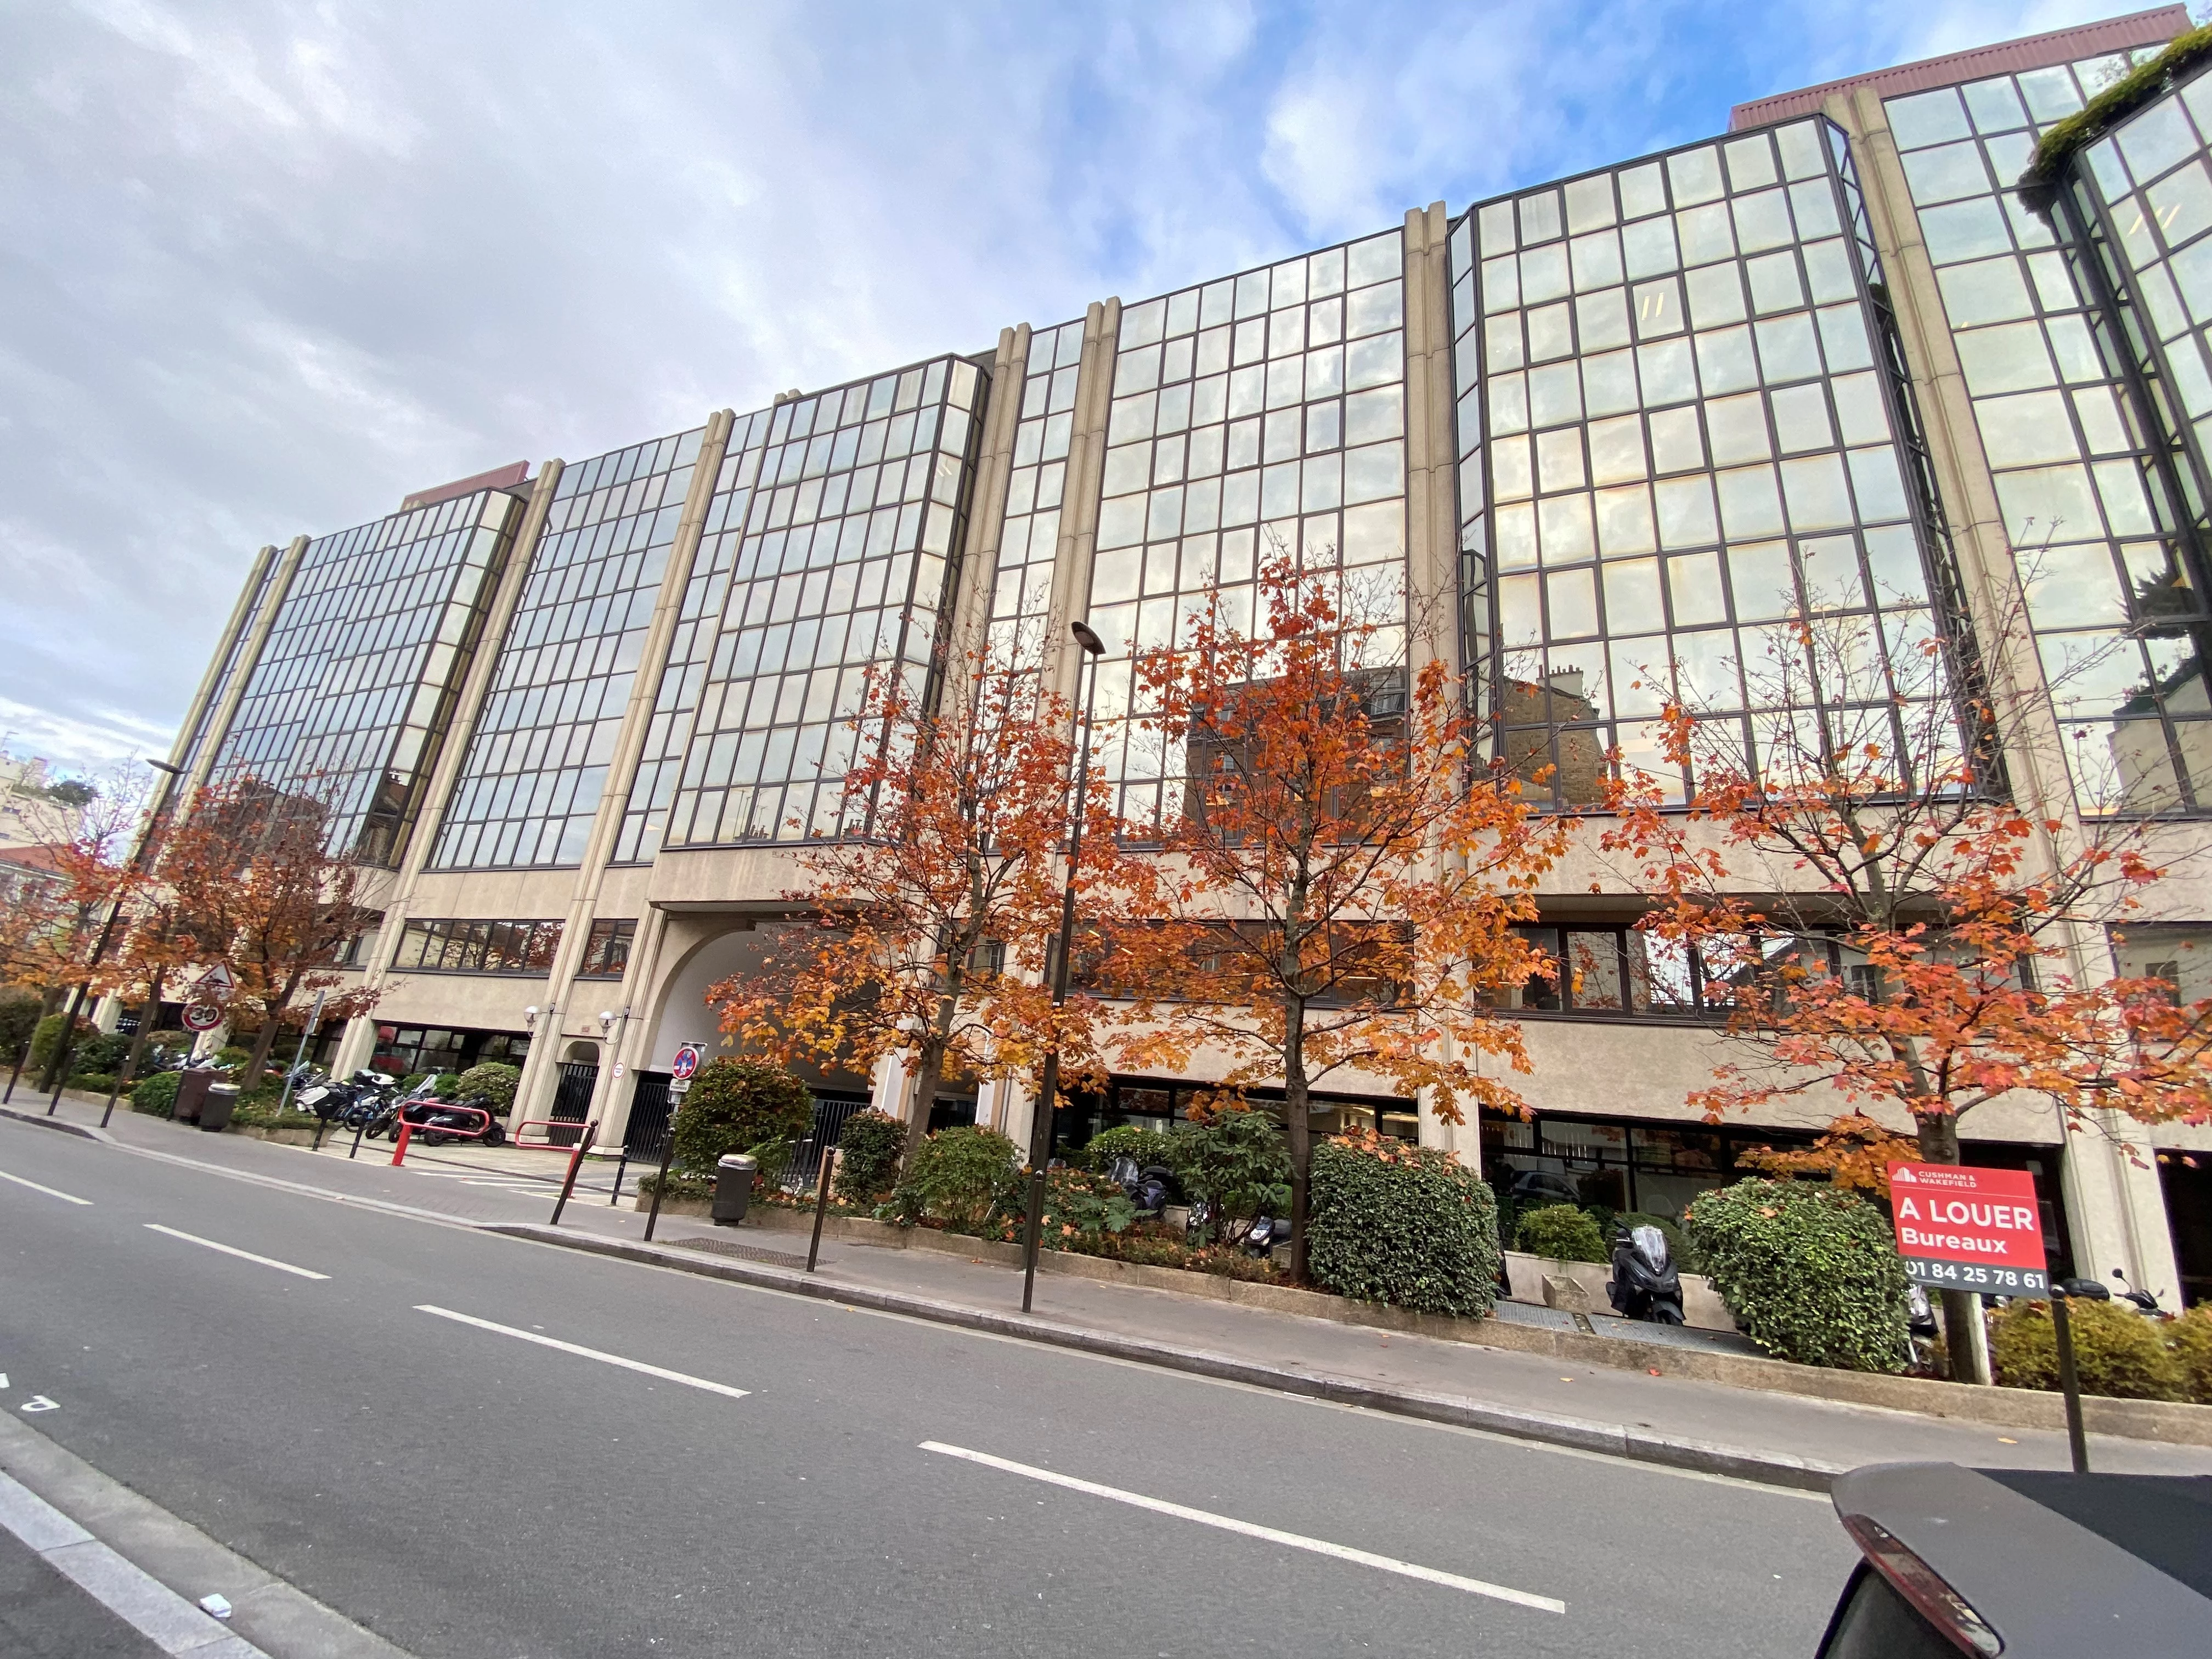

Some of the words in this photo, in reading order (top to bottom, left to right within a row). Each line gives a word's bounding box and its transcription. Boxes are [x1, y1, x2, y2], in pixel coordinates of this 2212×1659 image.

[1918, 1171, 1966, 1181] CUSHMAN
[1919, 1177, 1977, 1188] WAKEFIELD
[1899, 1197, 1921, 1221] A
[1928, 1199, 2035, 1231] LOUER
[1900, 1227, 2008, 1254] Bureaux
[1904, 1261, 1926, 1277] 01
[1931, 1263, 1957, 1280] 84
[1963, 1266, 1988, 1283] 25
[1992, 1269, 2018, 1286] 78
[2023, 1273, 2045, 1289] 61
